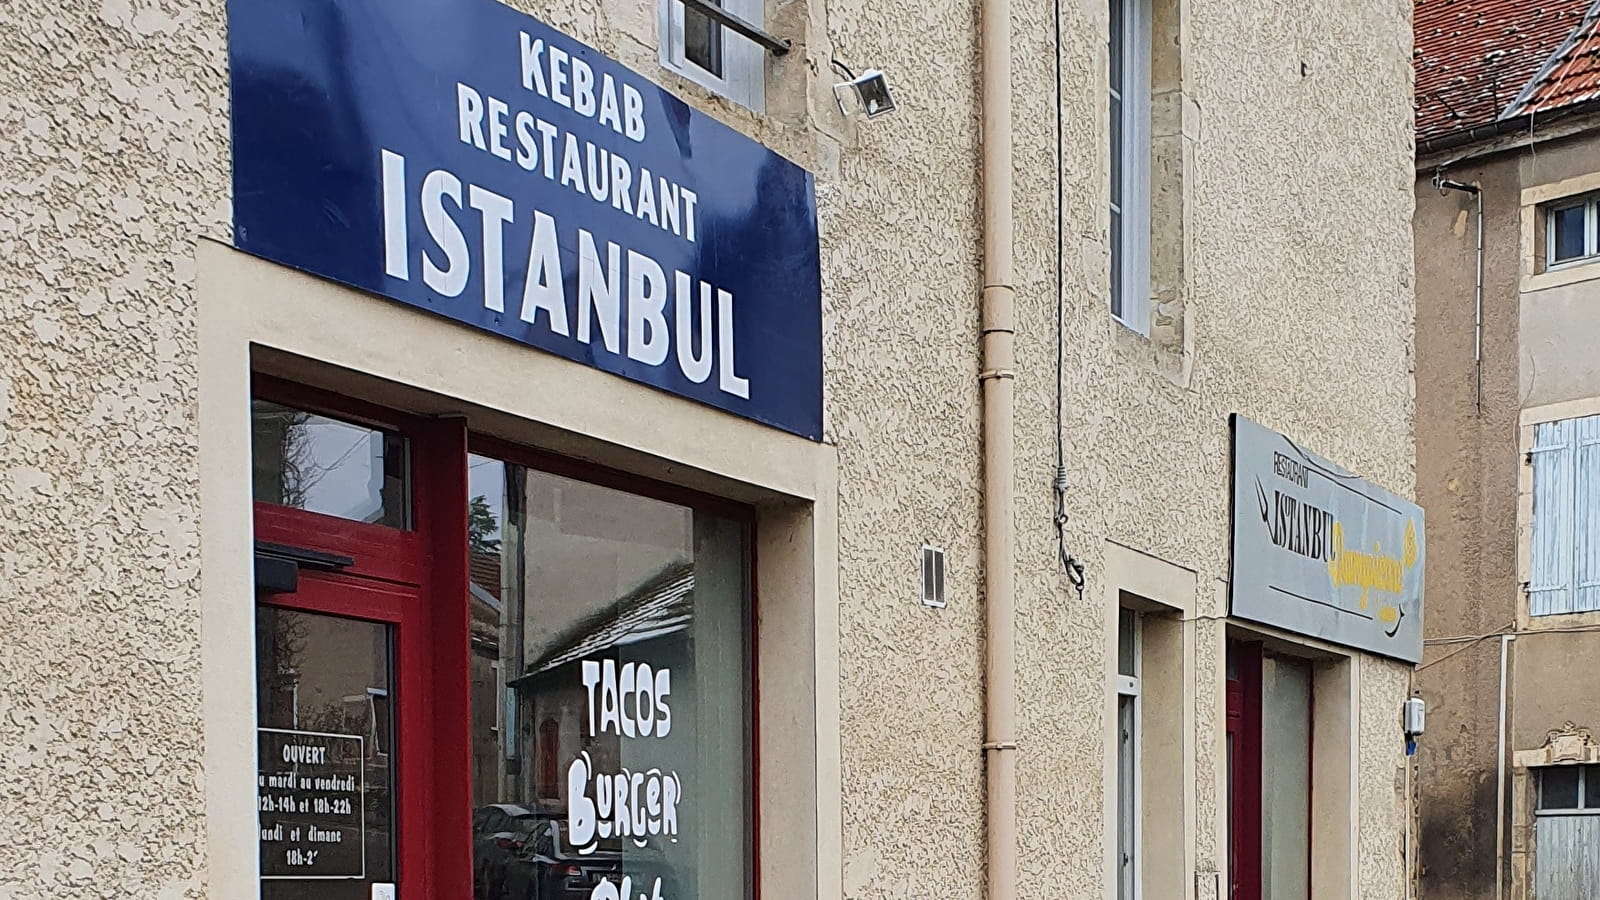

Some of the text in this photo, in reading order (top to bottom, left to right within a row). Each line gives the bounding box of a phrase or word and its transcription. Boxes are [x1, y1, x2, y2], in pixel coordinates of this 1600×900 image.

[519, 30, 645, 143] KEBAB
[457, 82, 698, 242] RESTAURANT
[381, 149, 750, 399] ISTANBUL
[582, 659, 671, 738] TACOS
[283, 744, 326, 765] OUVERT
[258, 794, 352, 814] 12h-14h et 18h-22h
[268, 772, 297, 788] mardi
[300, 777, 311, 789] au
[314, 774, 355, 791] vendredi
[290, 827, 301, 842] et
